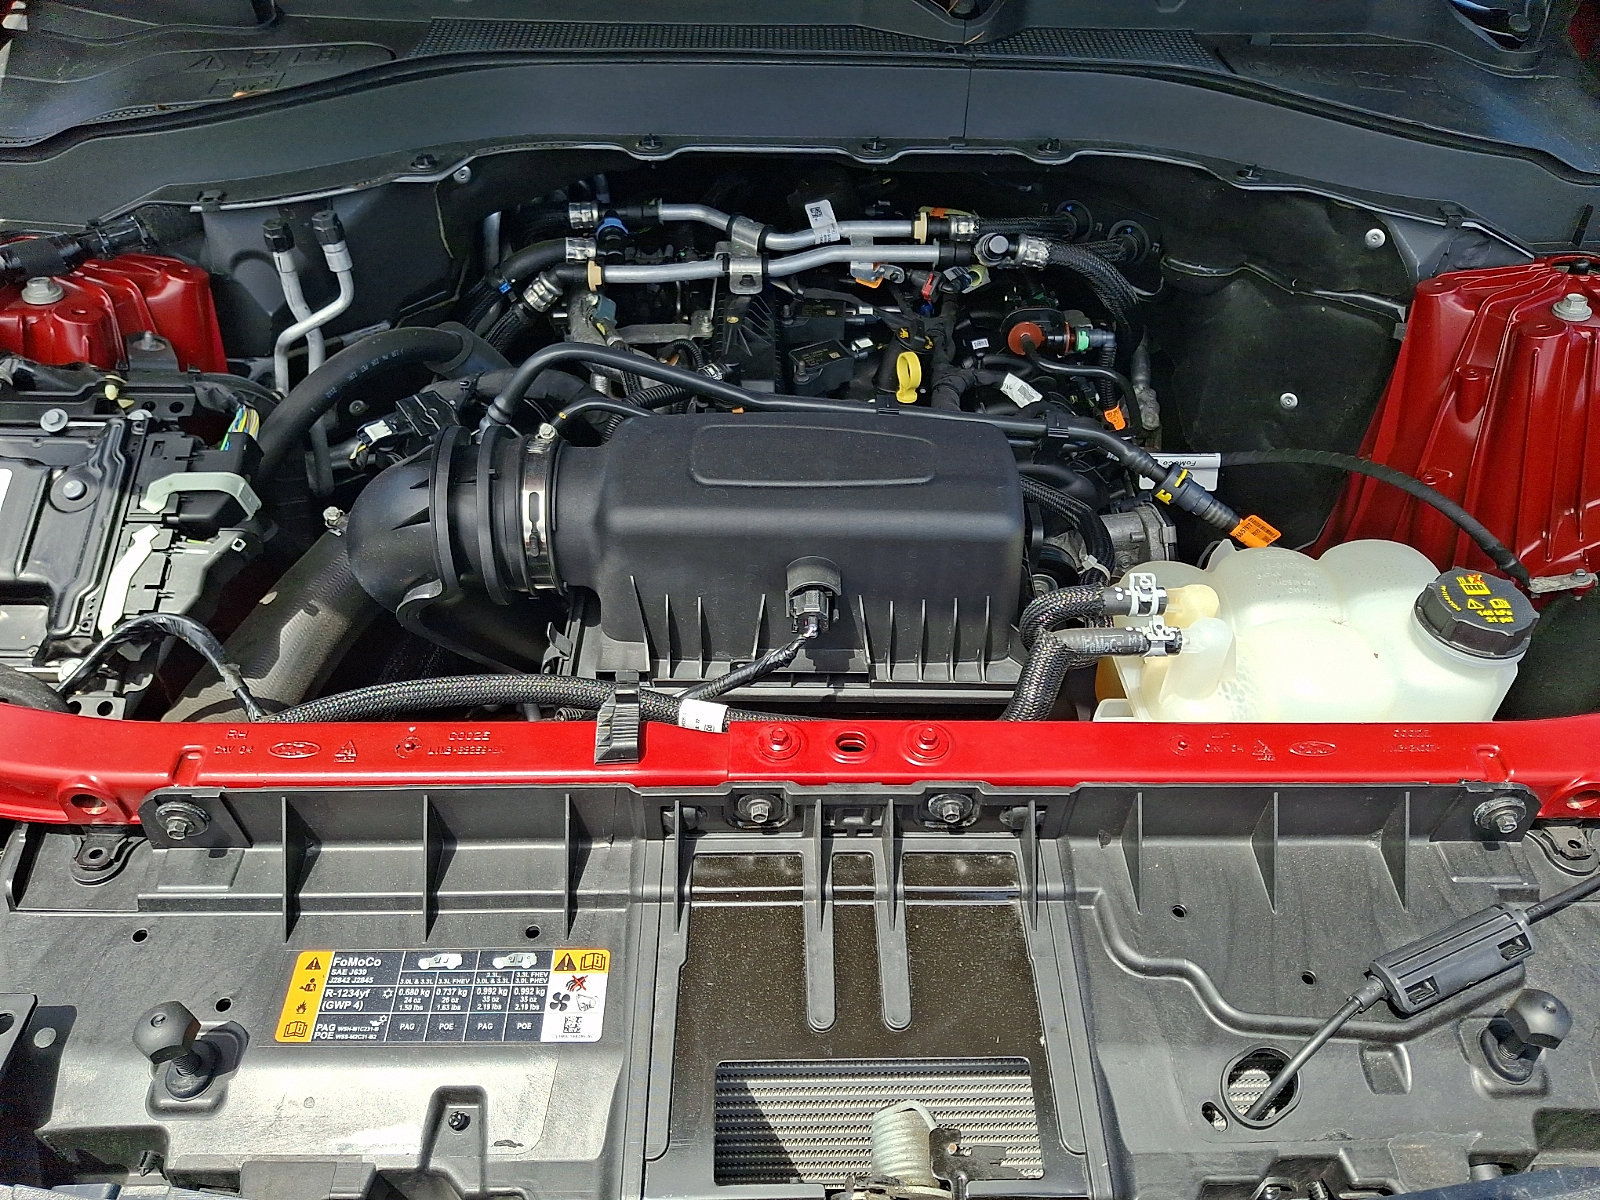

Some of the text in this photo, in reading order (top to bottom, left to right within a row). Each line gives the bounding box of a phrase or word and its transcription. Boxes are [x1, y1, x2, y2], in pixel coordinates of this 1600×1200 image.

[332, 956, 382, 967] FoMoCo
[331, 968, 368, 976] SAE J639
[324, 988, 371, 999] R-1234yf
[398, 988, 431, 998] 0.680 kg
[436, 988, 468, 997] 0.737 kg
[498, 988, 509, 997] kg
[536, 988, 546, 997] kg
[321, 1000, 363, 1011] (GWP 4)
[316, 1023, 336, 1032] PAG
[477, 1022, 494, 1030] PAG
[516, 1022, 532, 1030] POE
[313, 1031, 335, 1040] POE
